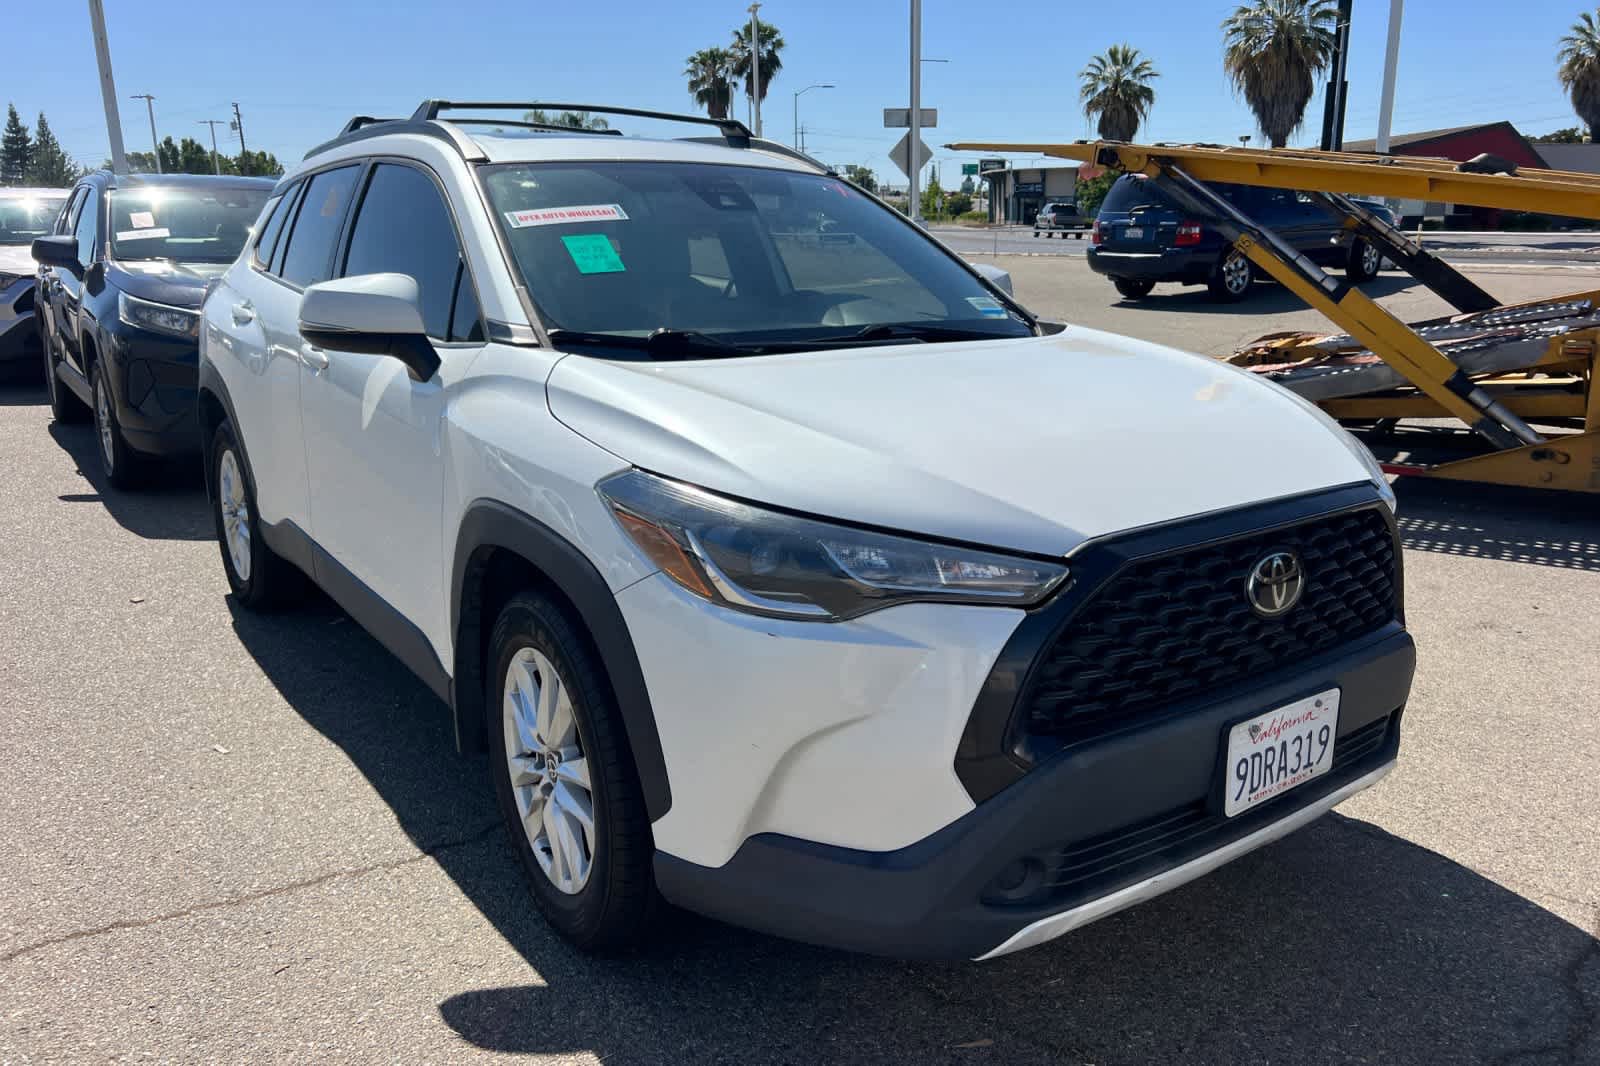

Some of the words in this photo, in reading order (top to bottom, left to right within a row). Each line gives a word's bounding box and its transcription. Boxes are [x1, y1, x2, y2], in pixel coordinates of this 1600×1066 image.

[542, 212, 565, 220] AUTO
[566, 208, 616, 218] WHOLESALE
[1248, 711, 1319, 745] California
[1234, 724, 1331, 802] 9DRA319
